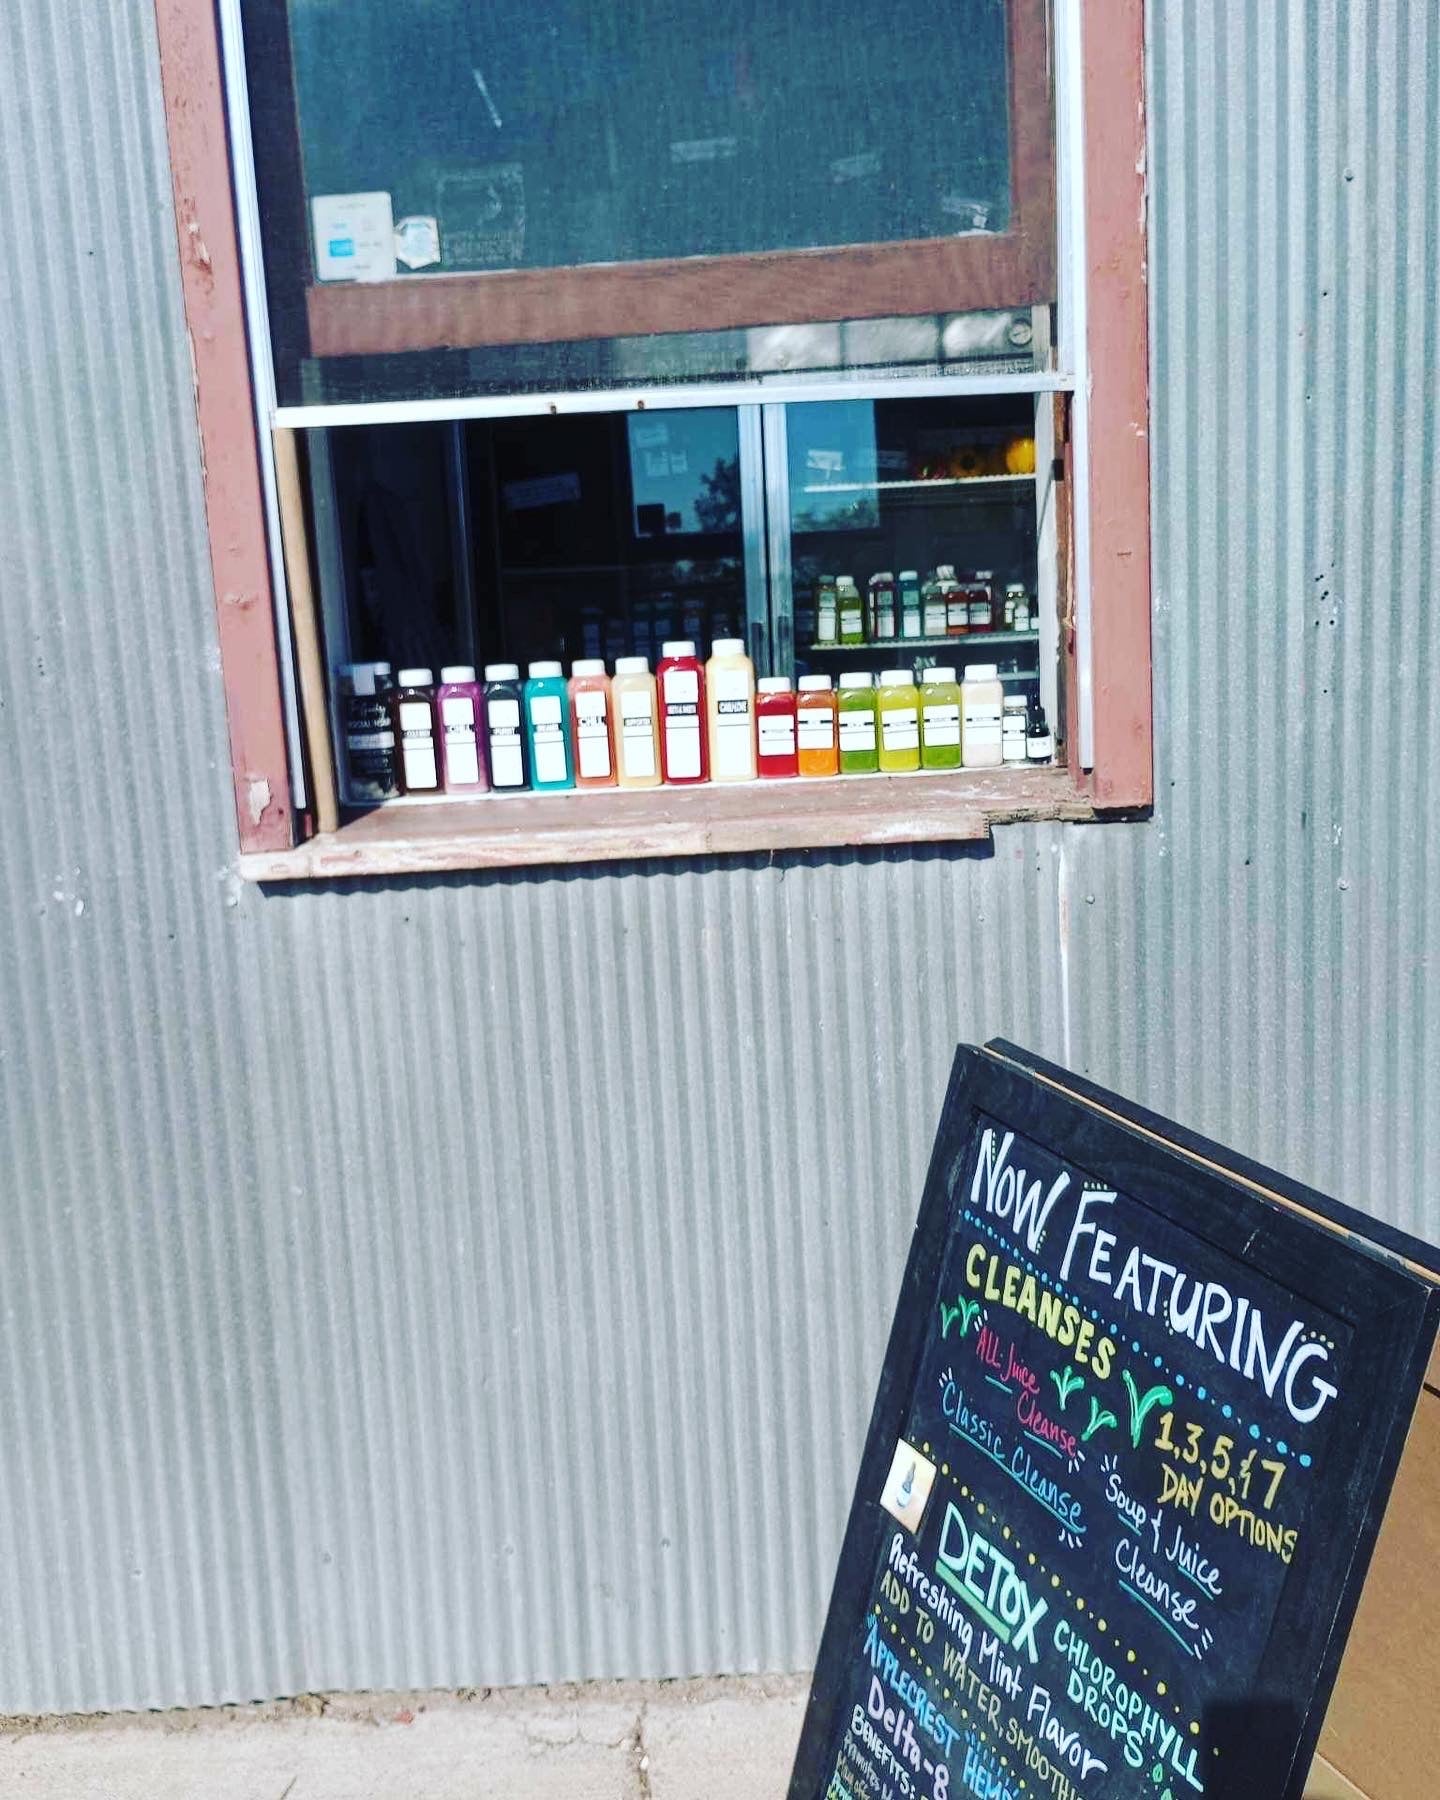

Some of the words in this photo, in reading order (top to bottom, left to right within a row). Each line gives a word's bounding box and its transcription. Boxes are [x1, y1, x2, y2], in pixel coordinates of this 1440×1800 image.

[965, 1243, 1117, 1379] CLEANSES
[1000, 1342, 1040, 1394] Juice
[1059, 1190, 1338, 1423] FEATURING
[942, 1381, 1006, 1459] Classic
[1011, 1446, 1087, 1532] Cleanse
[1016, 1391, 1077, 1457] Cleanse
[1105, 1473, 1147, 1530] Soup
[1165, 1524, 1223, 1596] Juice
[1157, 1462, 1204, 1517] DAY
[1209, 1492, 1299, 1564] OPTIONS
[880, 1569, 911, 1615] ADD
[915, 1606, 935, 1645] TO
[938, 1500, 1049, 1664] DETOX
[1115, 1538, 1200, 1630] Cleanse
[863, 1619, 961, 1758] APPLECREST
[888, 1532, 974, 1664] Refreshing
[978, 1631, 1023, 1701] Mint
[1026, 1684, 1109, 1781] Flavor
[1053, 1619, 1204, 1793] CHLOROPHYLL
[1066, 1668, 1144, 1768] DROPS
